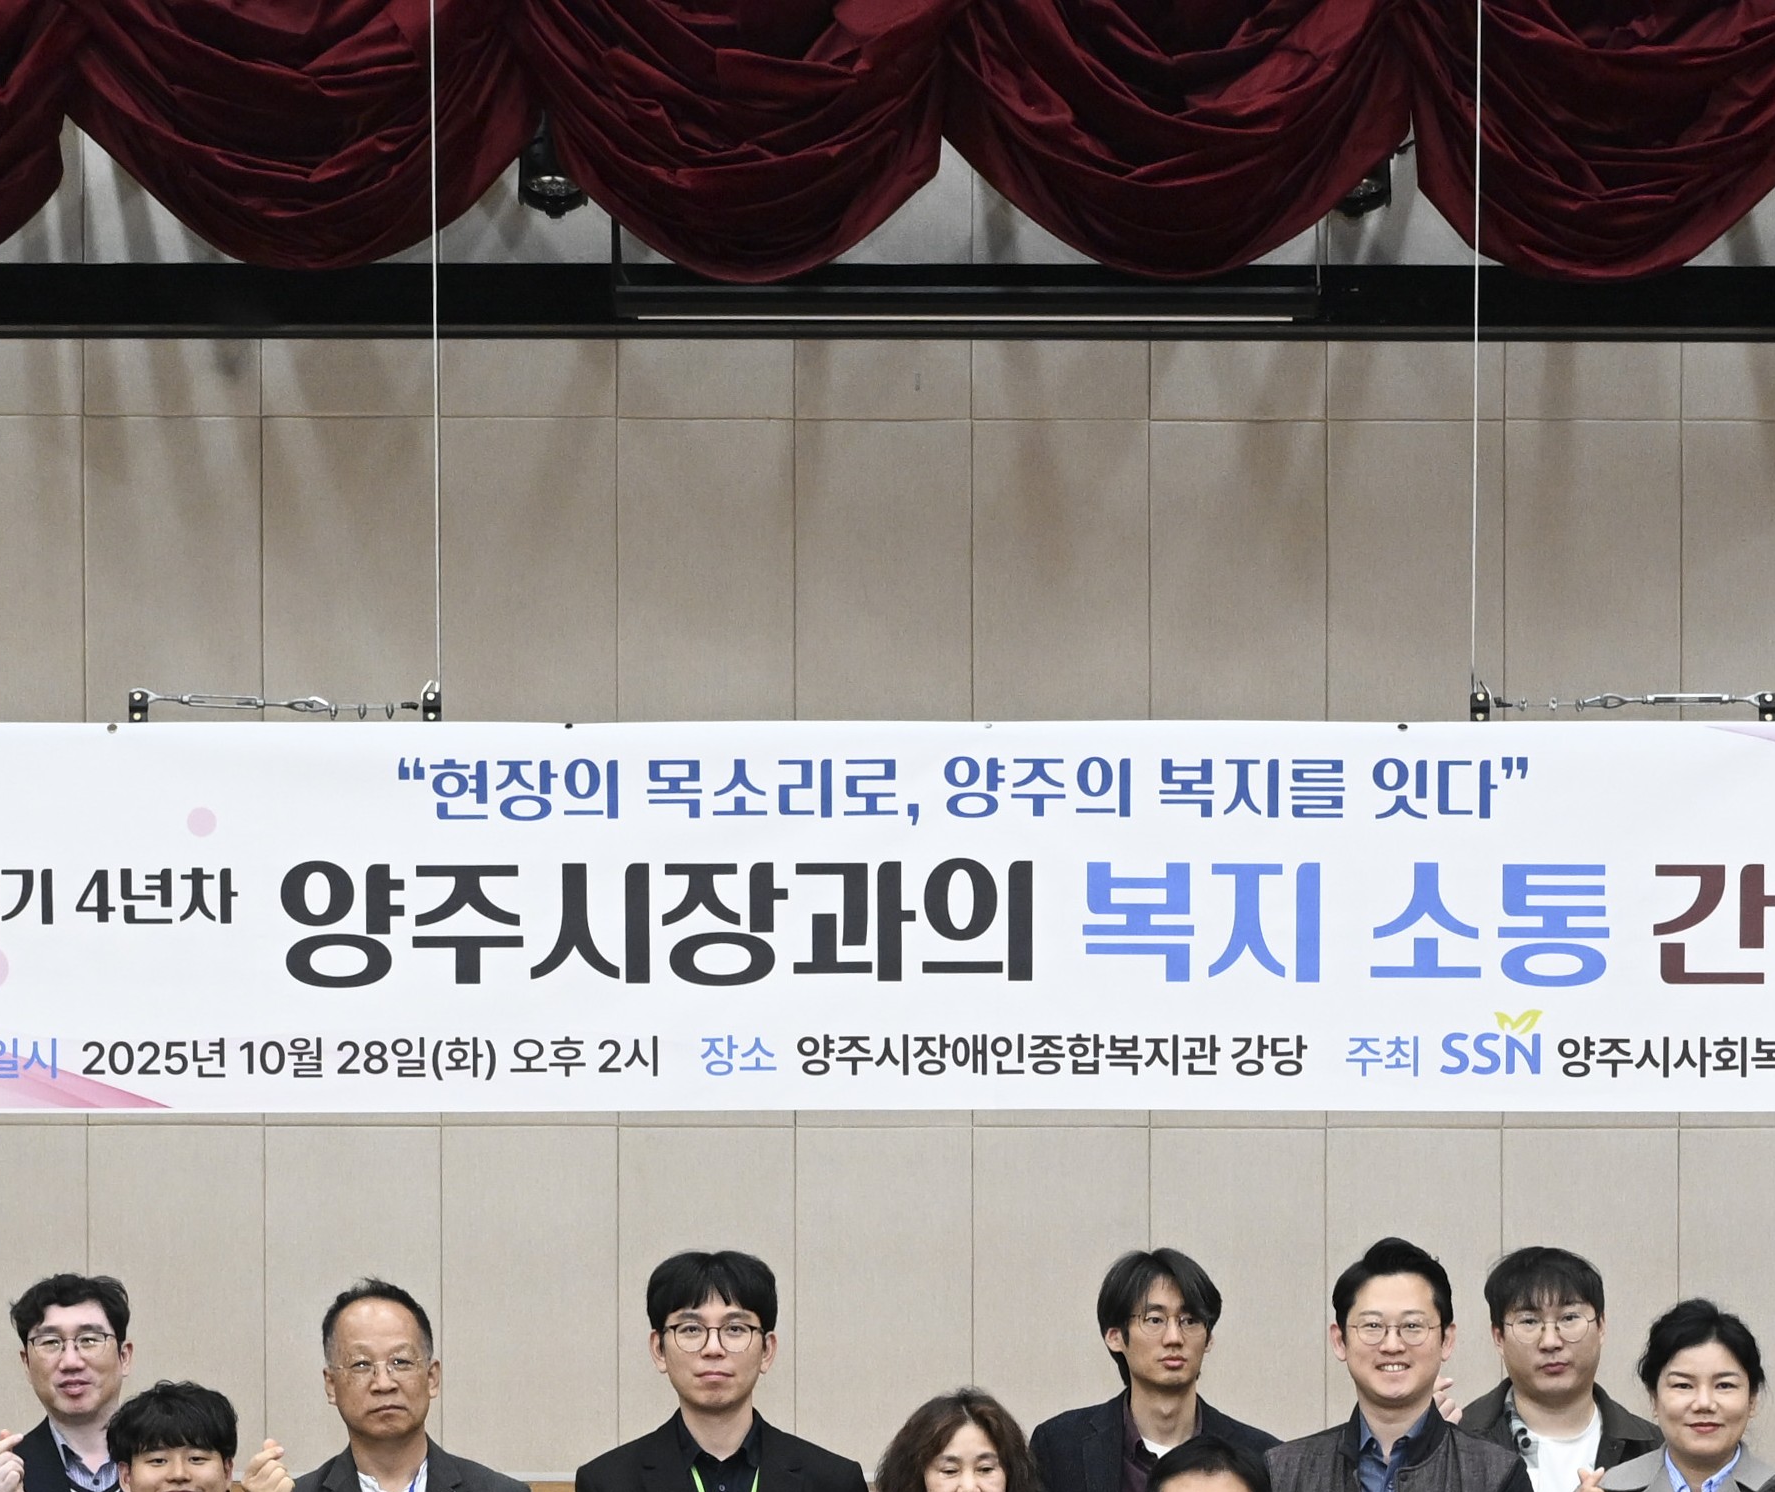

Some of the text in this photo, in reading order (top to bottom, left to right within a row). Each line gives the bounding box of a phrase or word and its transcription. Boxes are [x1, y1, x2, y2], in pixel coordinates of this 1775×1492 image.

[398, 756, 1528, 825] “현장의 목소리로, 양주의 복지를 잇다”
[76, 867, 238, 924] 4년차
[280, 858, 1033, 988] 양주시장과의
[1083, 862, 1320, 982] 복지
[1371, 863, 1609, 986] 소통
[83, 1038, 225, 1077] 2025년
[240, 1037, 322, 1077] 10월
[337, 1037, 496, 1080] 28일(화)
[510, 1037, 586, 1077] 오후
[599, 1036, 658, 1076] 2시
[702, 1035, 776, 1076] 장소
[797, 1034, 1220, 1075] 양주시장애인종합복지관
[1231, 1035, 1307, 1076] 강당
[1346, 1036, 1418, 1076] 주최
[1441, 1033, 1540, 1075] SSN
